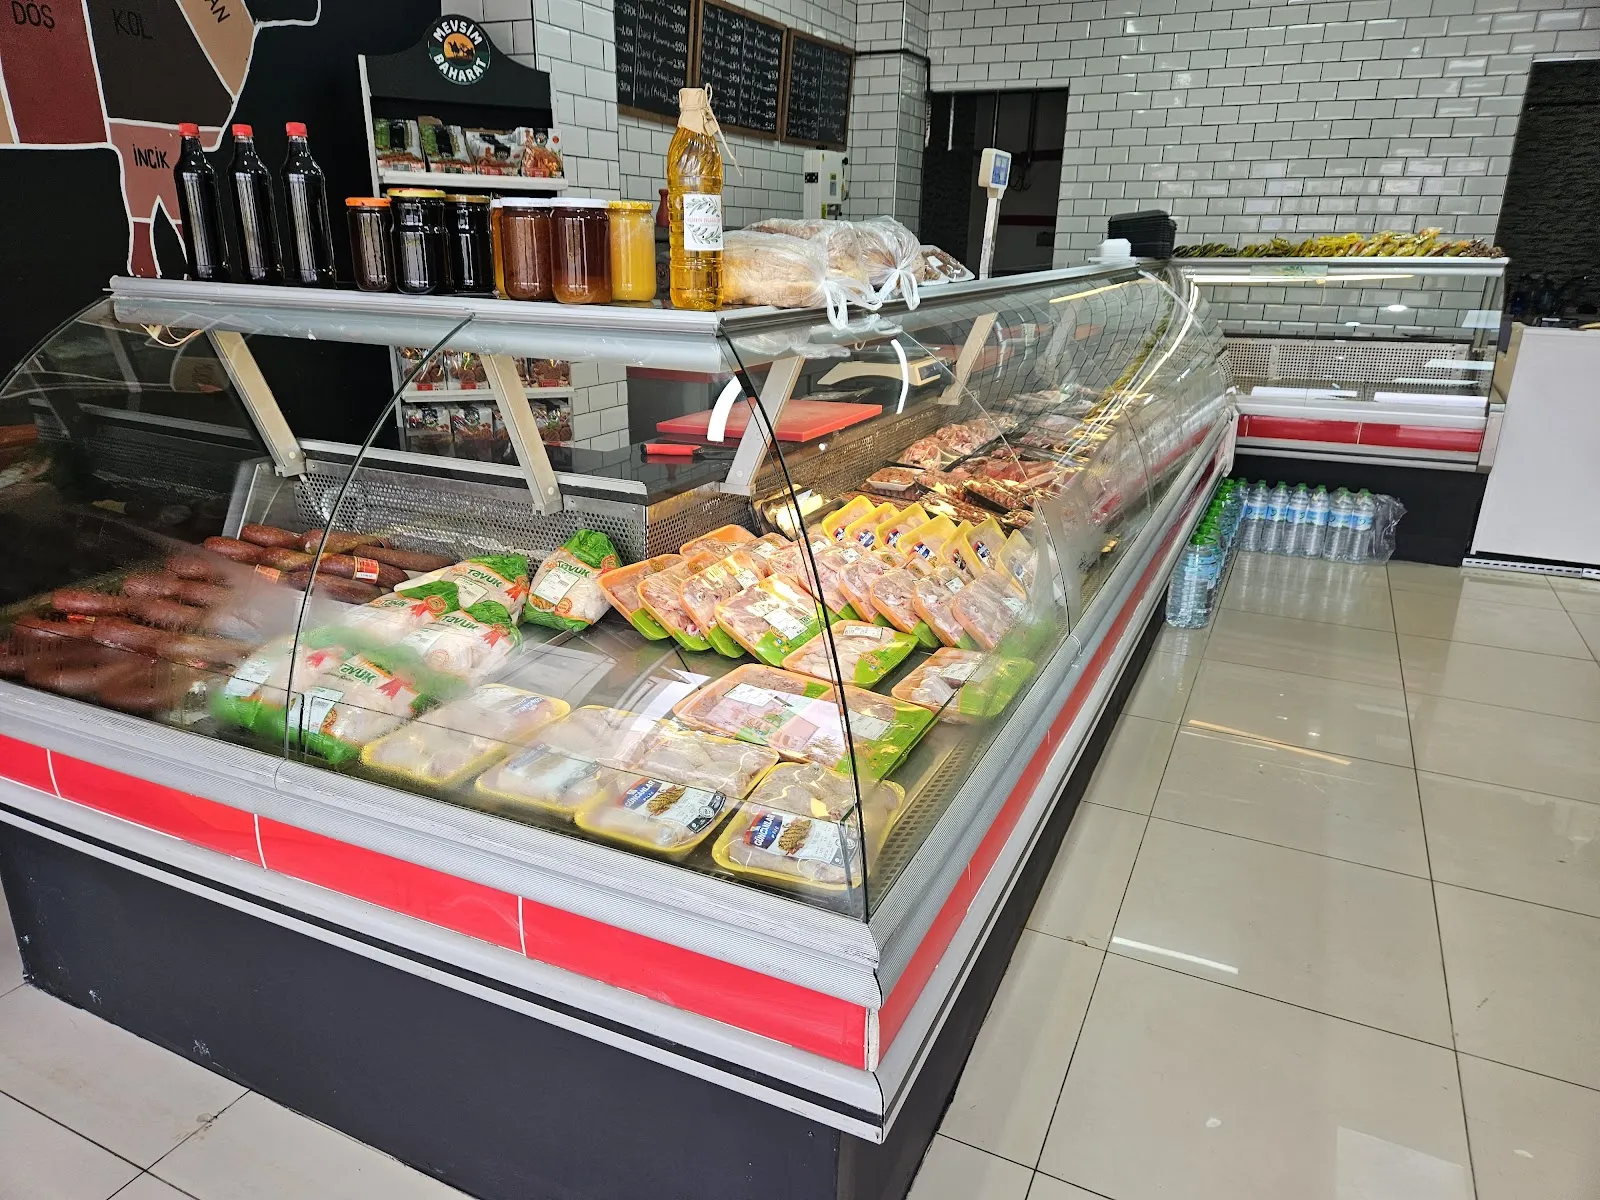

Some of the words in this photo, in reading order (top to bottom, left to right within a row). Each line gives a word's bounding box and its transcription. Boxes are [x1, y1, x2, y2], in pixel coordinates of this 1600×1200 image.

[111, 8, 154, 39] KOL
[433, 19, 483, 46] MEVSİM
[433, 53, 487, 83] BAHARAT
[132, 143, 170, 170] İNCİK
